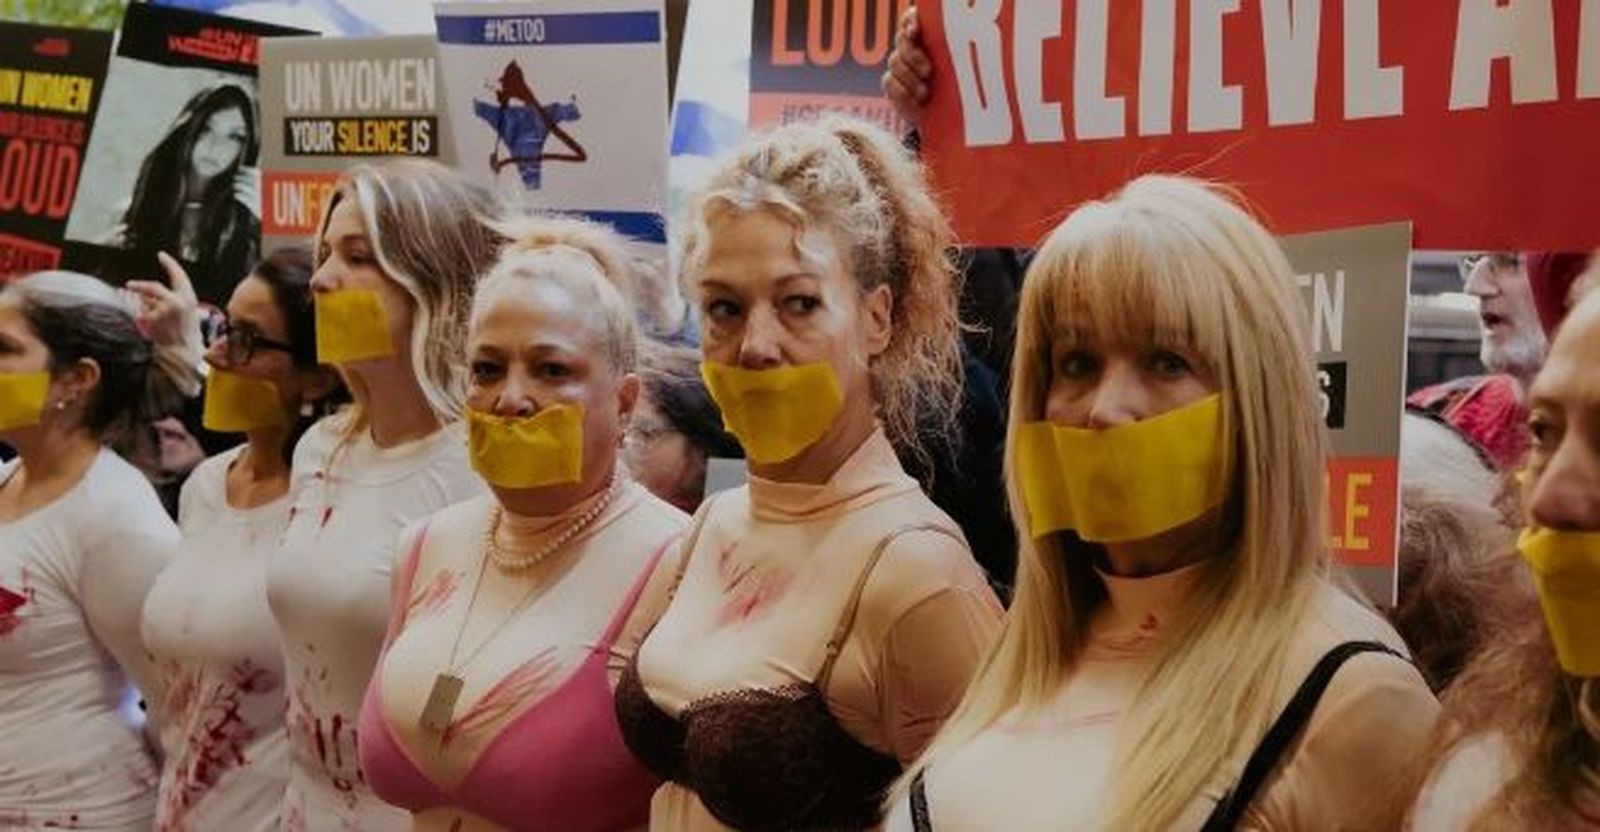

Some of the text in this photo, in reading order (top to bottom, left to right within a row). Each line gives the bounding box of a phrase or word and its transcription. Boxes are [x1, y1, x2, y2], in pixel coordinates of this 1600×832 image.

[484, 18, 545, 42] #METOO
[771, 0, 905, 66] LOU
[20, 72, 93, 113] WOMEN
[285, 58, 435, 110] UN WOMEN
[290, 119, 431, 154] YOUR SILENCE IS
[273, 180, 334, 228] UNF
[1296, 269, 1345, 352] N
[1328, 472, 1373, 550] E
